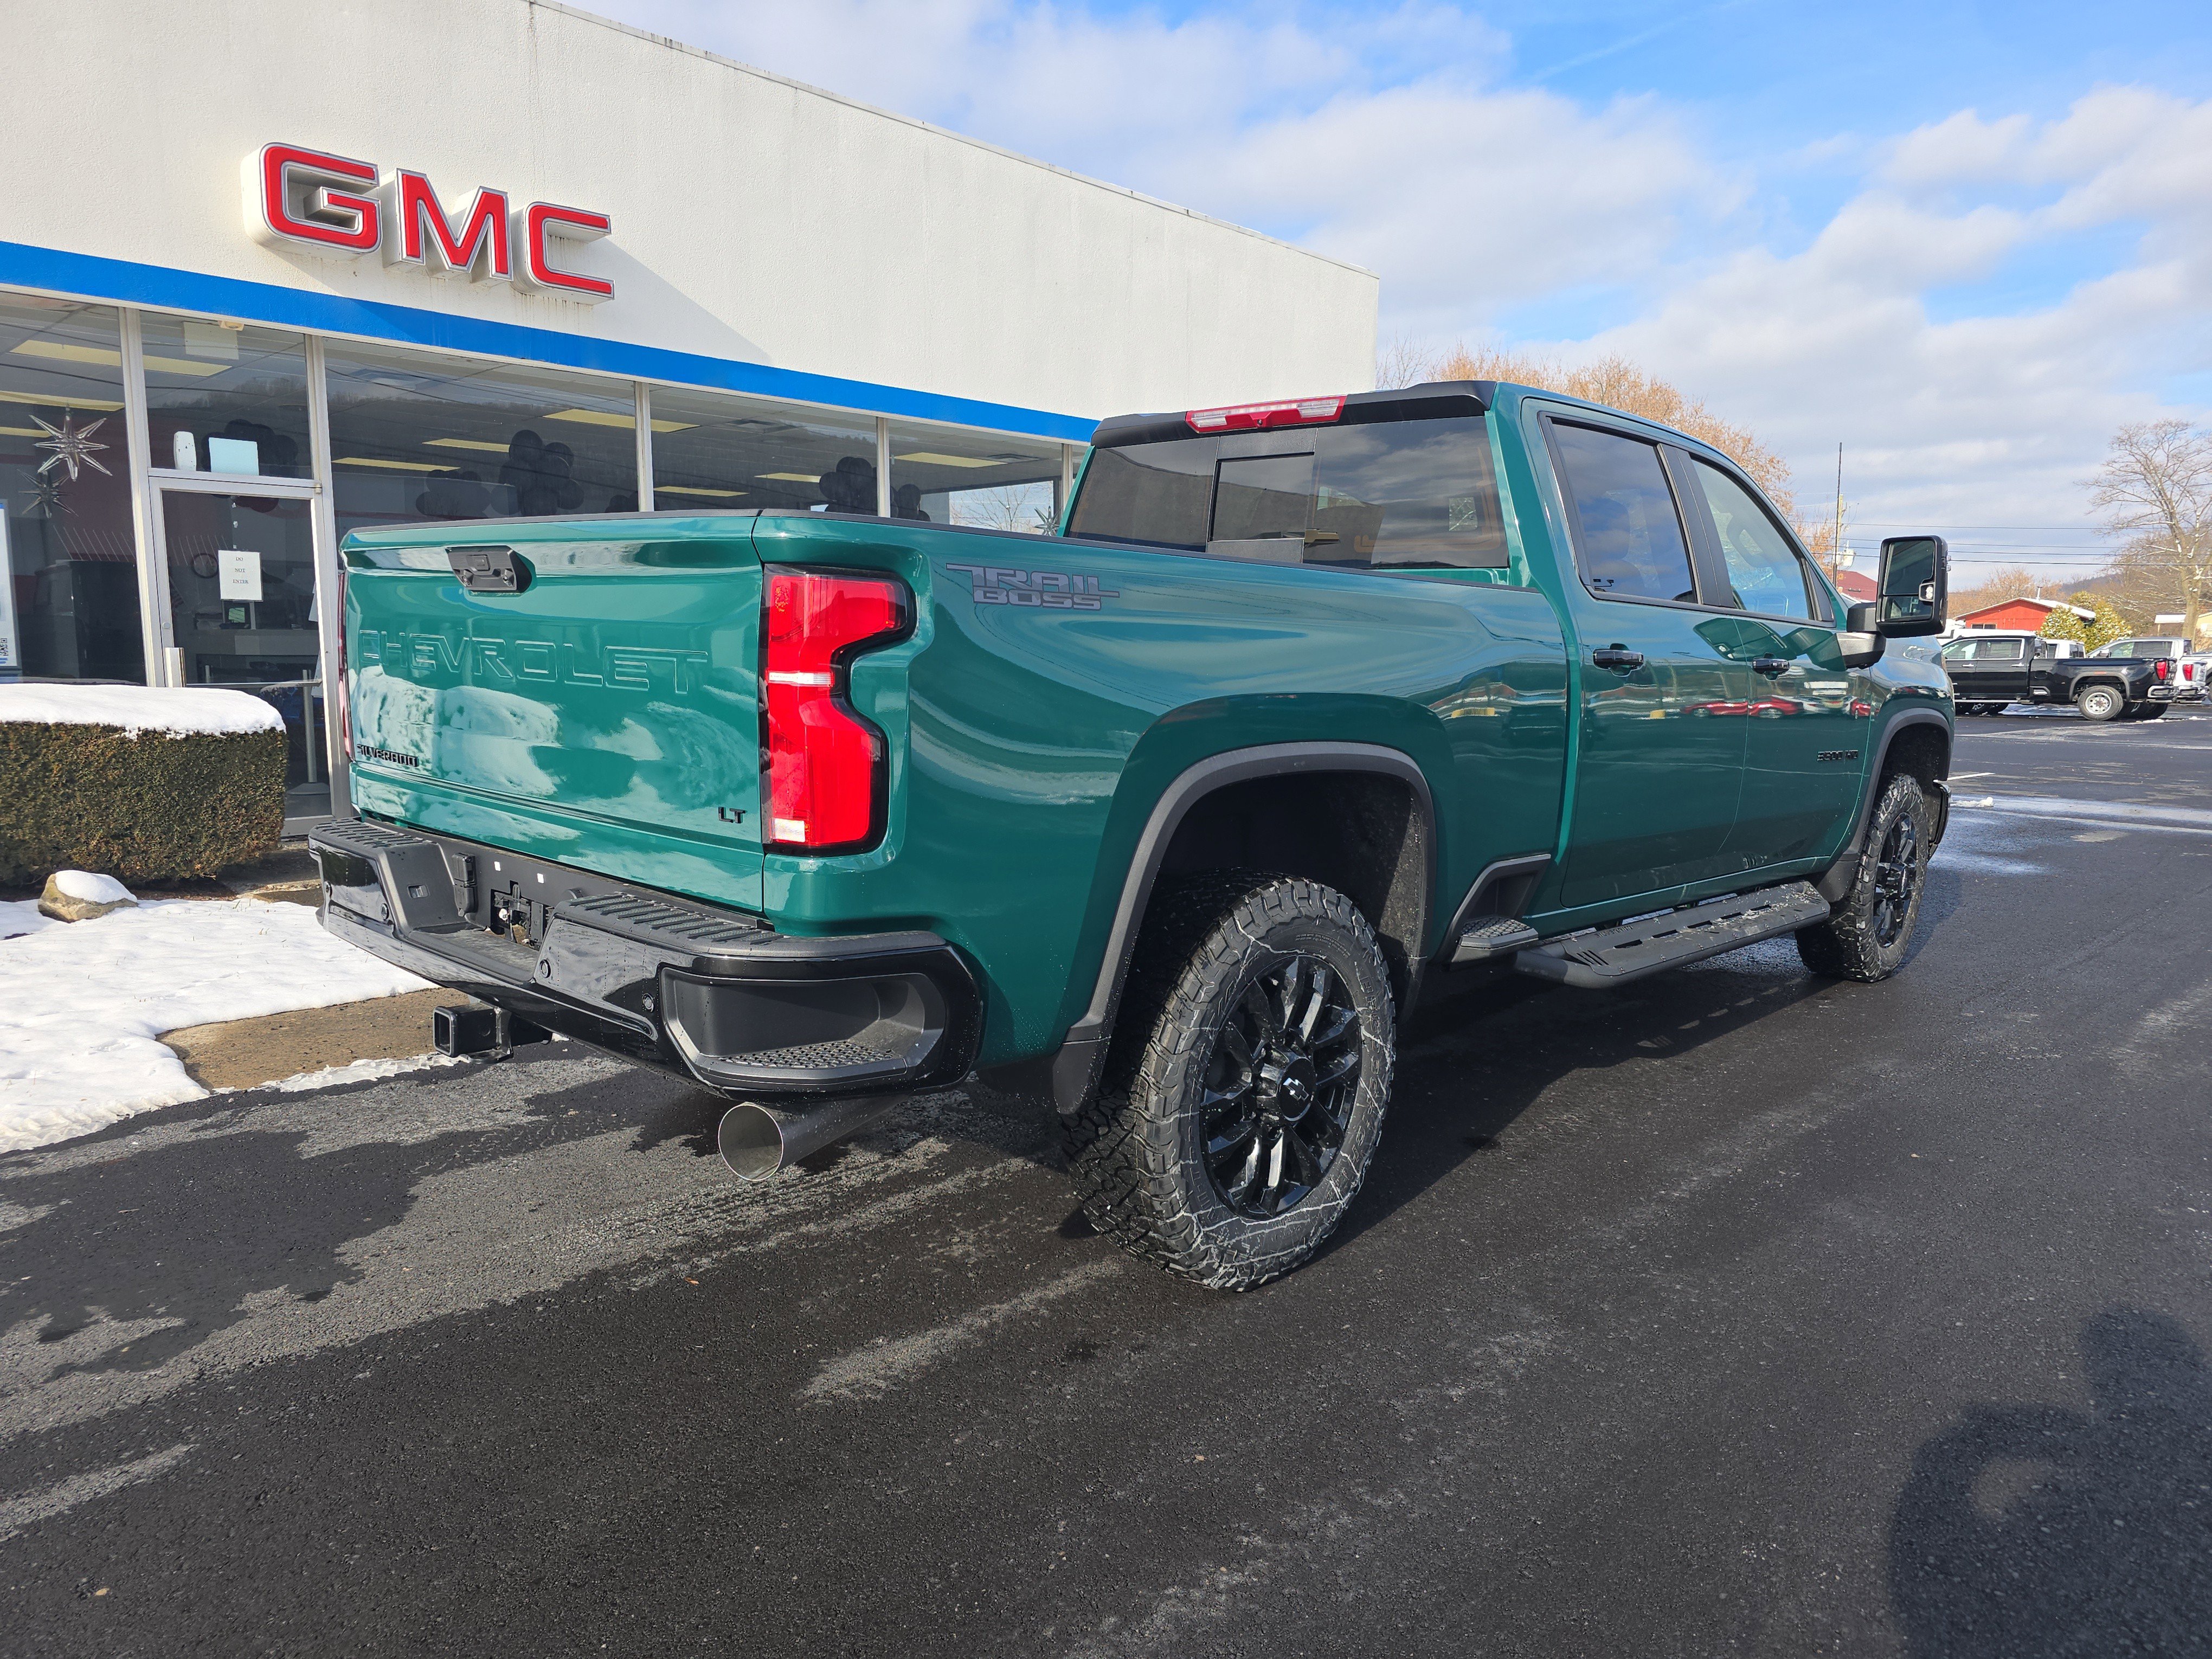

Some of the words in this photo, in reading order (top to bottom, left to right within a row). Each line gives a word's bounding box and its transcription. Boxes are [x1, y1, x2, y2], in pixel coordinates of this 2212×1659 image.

[257, 142, 615, 300] GMC
[946, 563, 1120, 598] TRAIL
[973, 586, 1102, 612] BOSS
[359, 630, 708, 695] CHEVROLET
[357, 743, 419, 767] SILVERADO
[718, 806, 747, 824] LT
